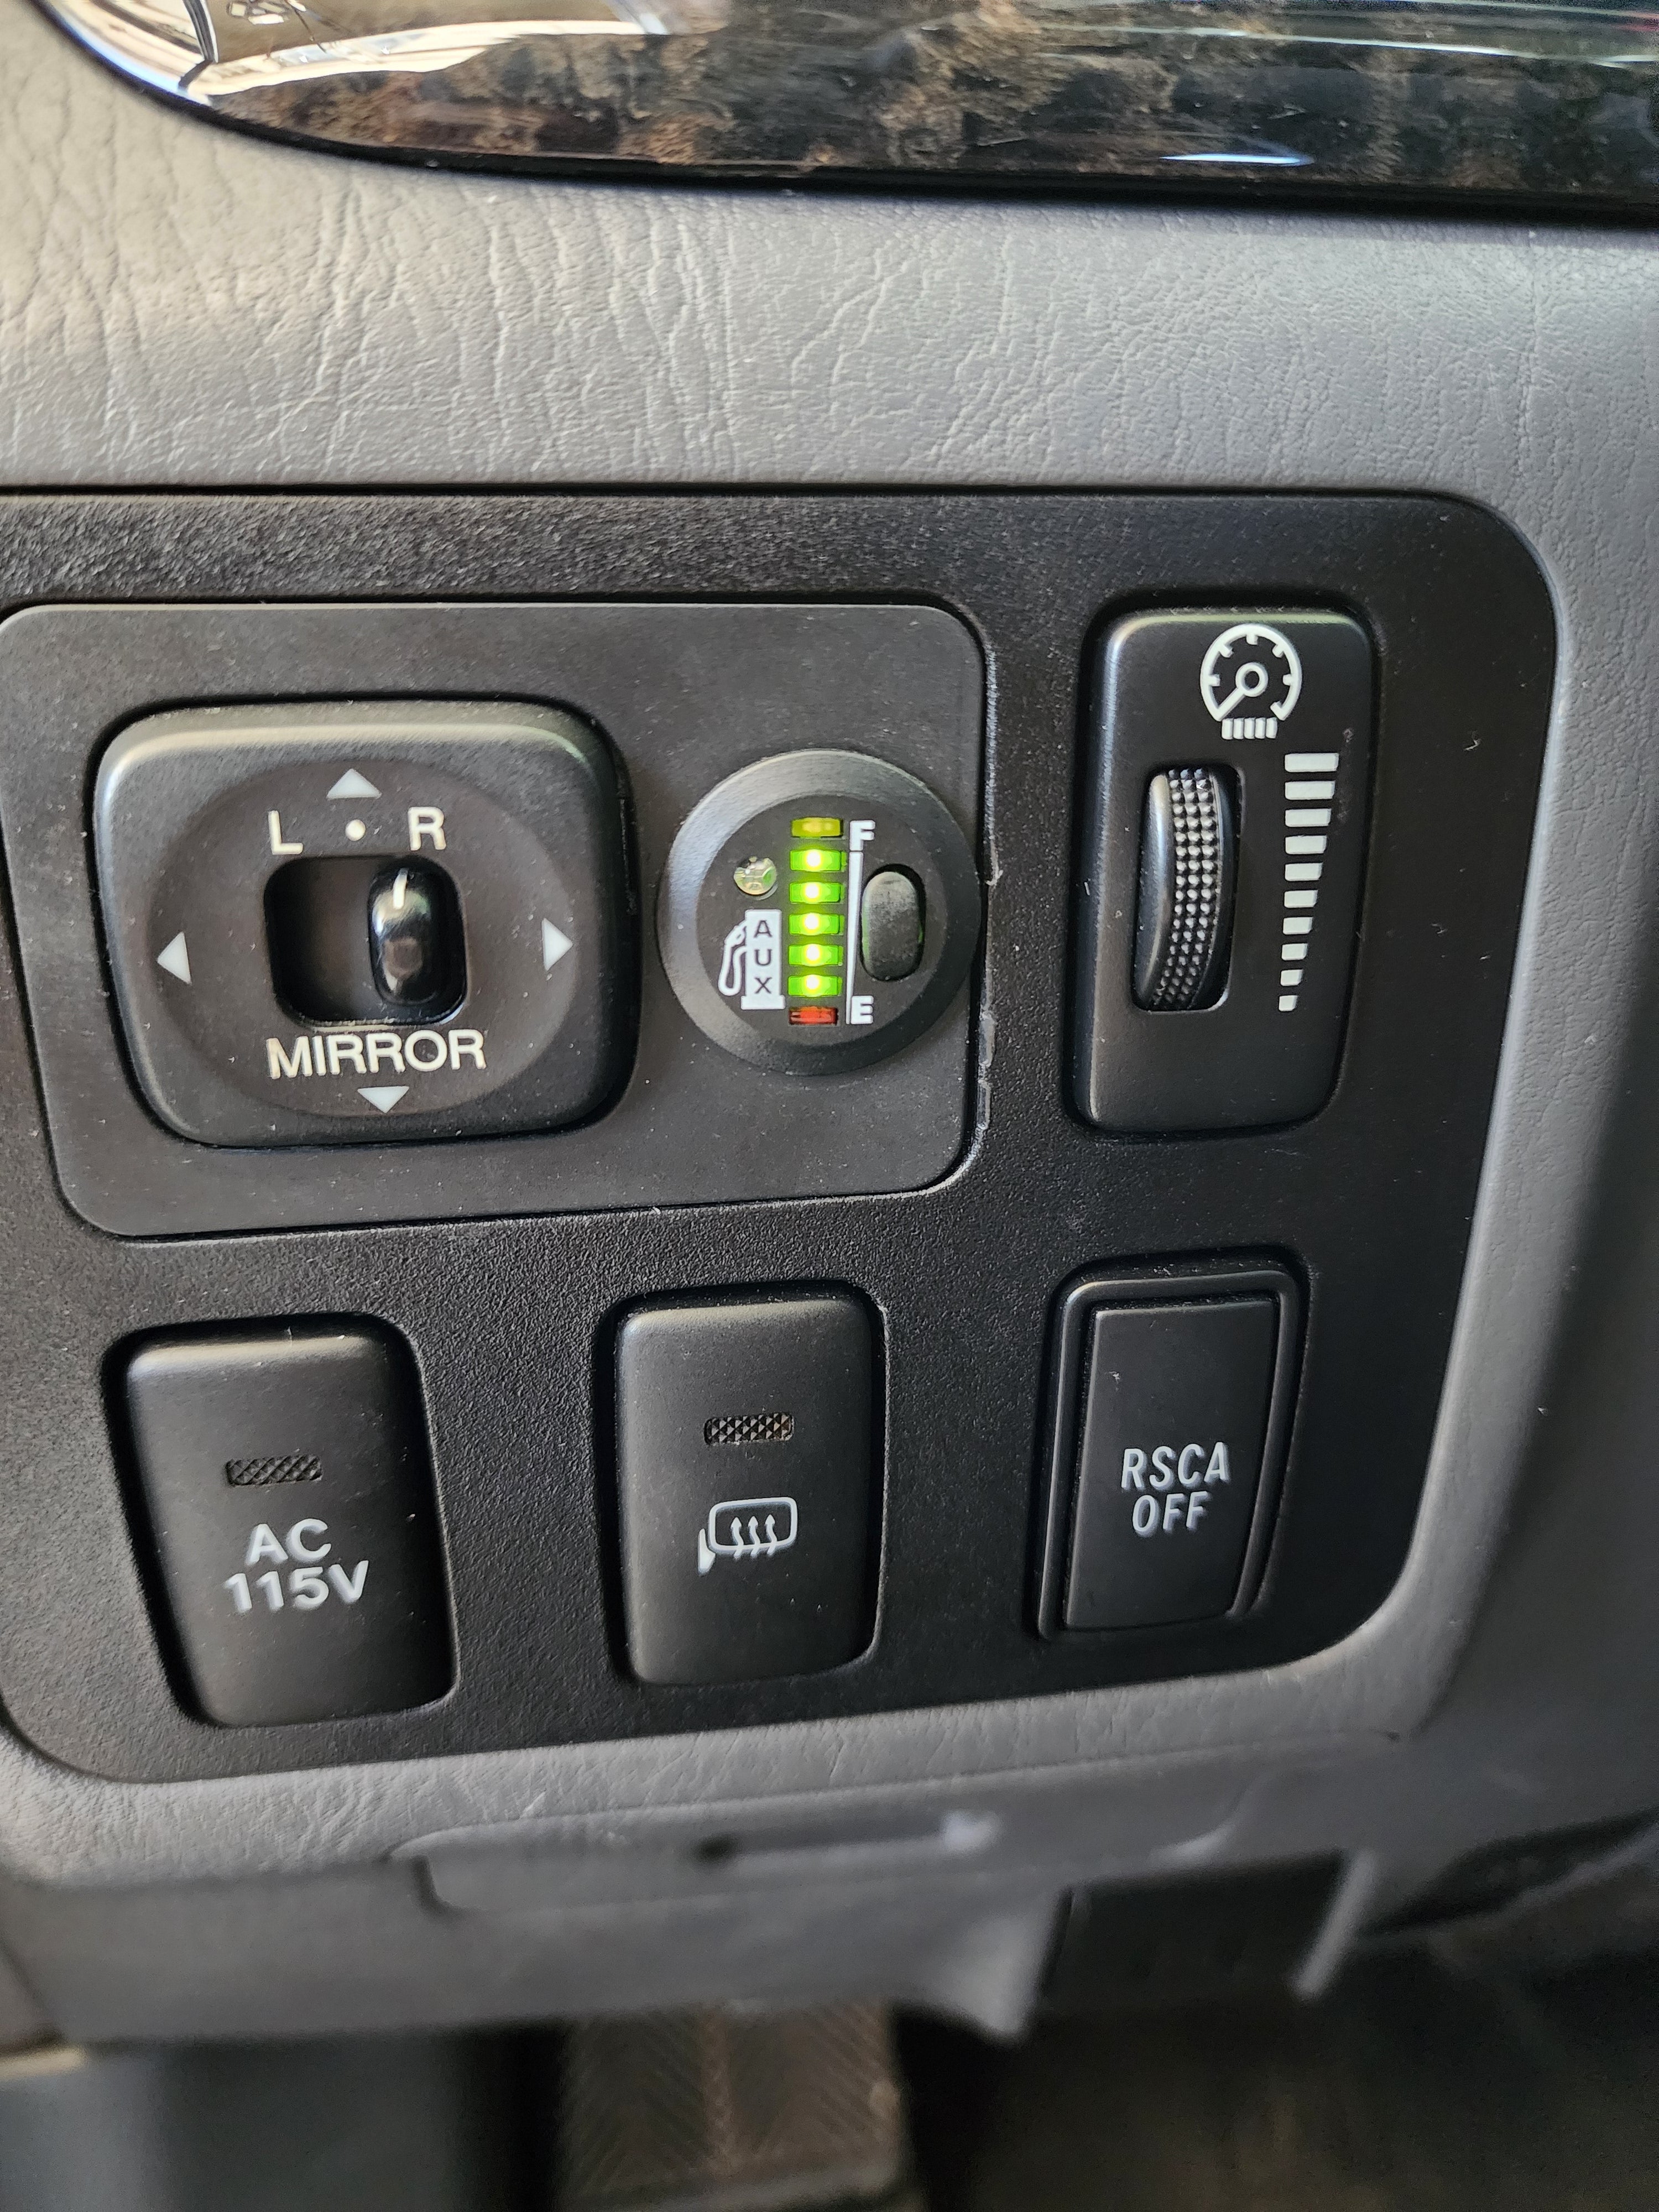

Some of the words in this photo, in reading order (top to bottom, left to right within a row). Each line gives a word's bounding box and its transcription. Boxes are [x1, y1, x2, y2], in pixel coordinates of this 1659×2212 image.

[268, 810, 304, 854] L
[408, 806, 446, 850] R
[849, 820, 875, 851] F
[754, 920, 772, 994] AUX
[850, 996, 874, 1025] E
[266, 1029, 487, 1079] MIRROR
[1121, 1442, 1230, 1490] RSCA
[1132, 1491, 1212, 1537] OFF
[246, 1518, 332, 1566] AC
[223, 1560, 369, 1613] 115V
